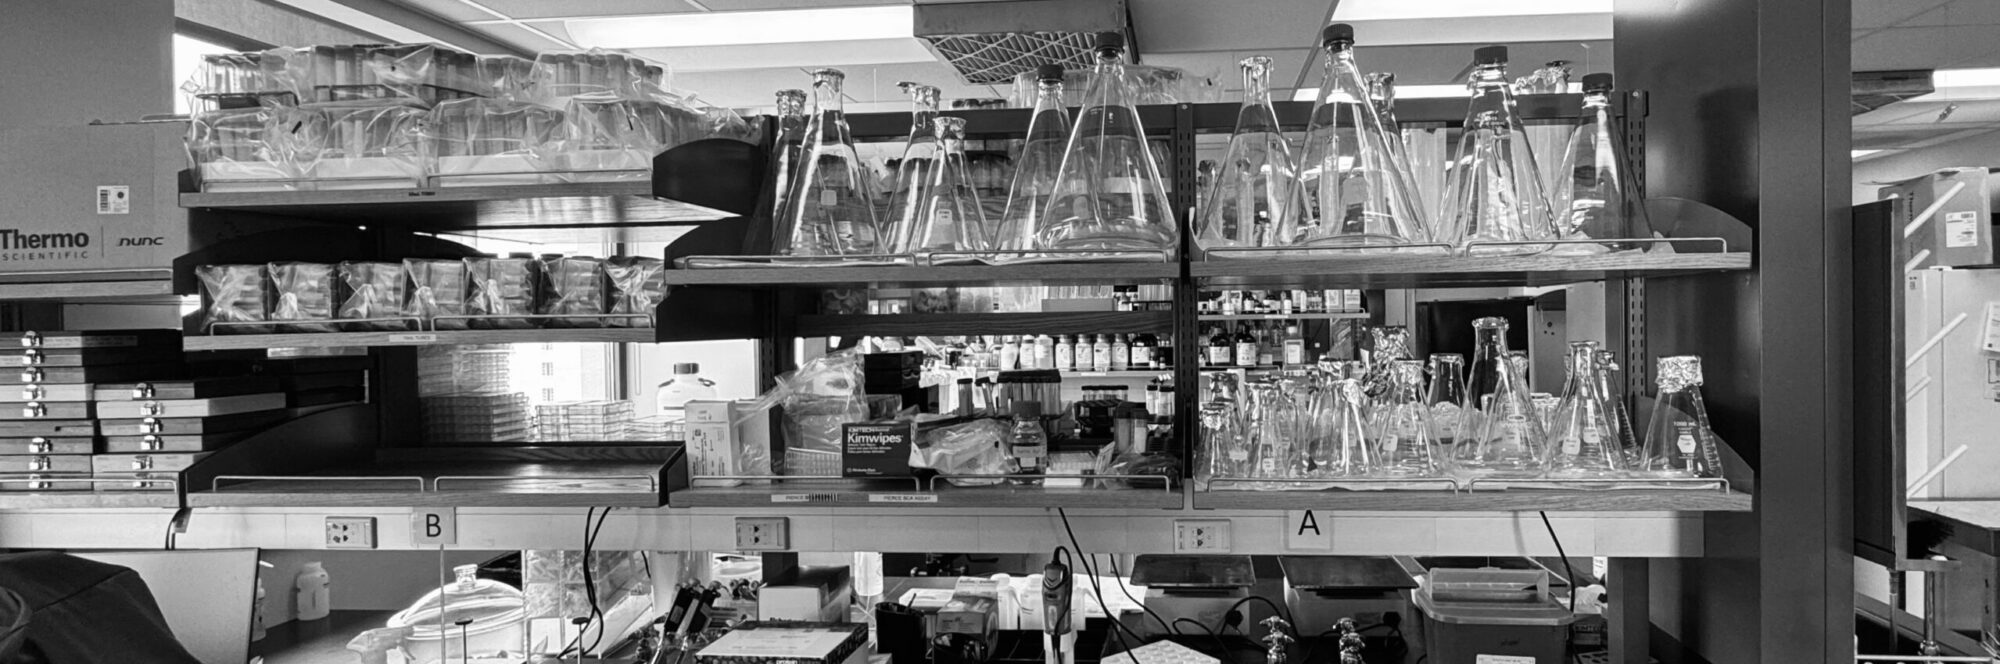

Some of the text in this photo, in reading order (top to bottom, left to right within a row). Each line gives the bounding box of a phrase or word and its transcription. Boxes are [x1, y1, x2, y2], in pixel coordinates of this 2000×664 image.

[0, 229, 89, 249] Thermo
[118, 236, 165, 247] nunc
[2, 251, 89, 261] SCIENTIFIC
[847, 432, 903, 446] Kimwipes
[426, 514, 441, 537] B
[1298, 510, 1320, 535] A
